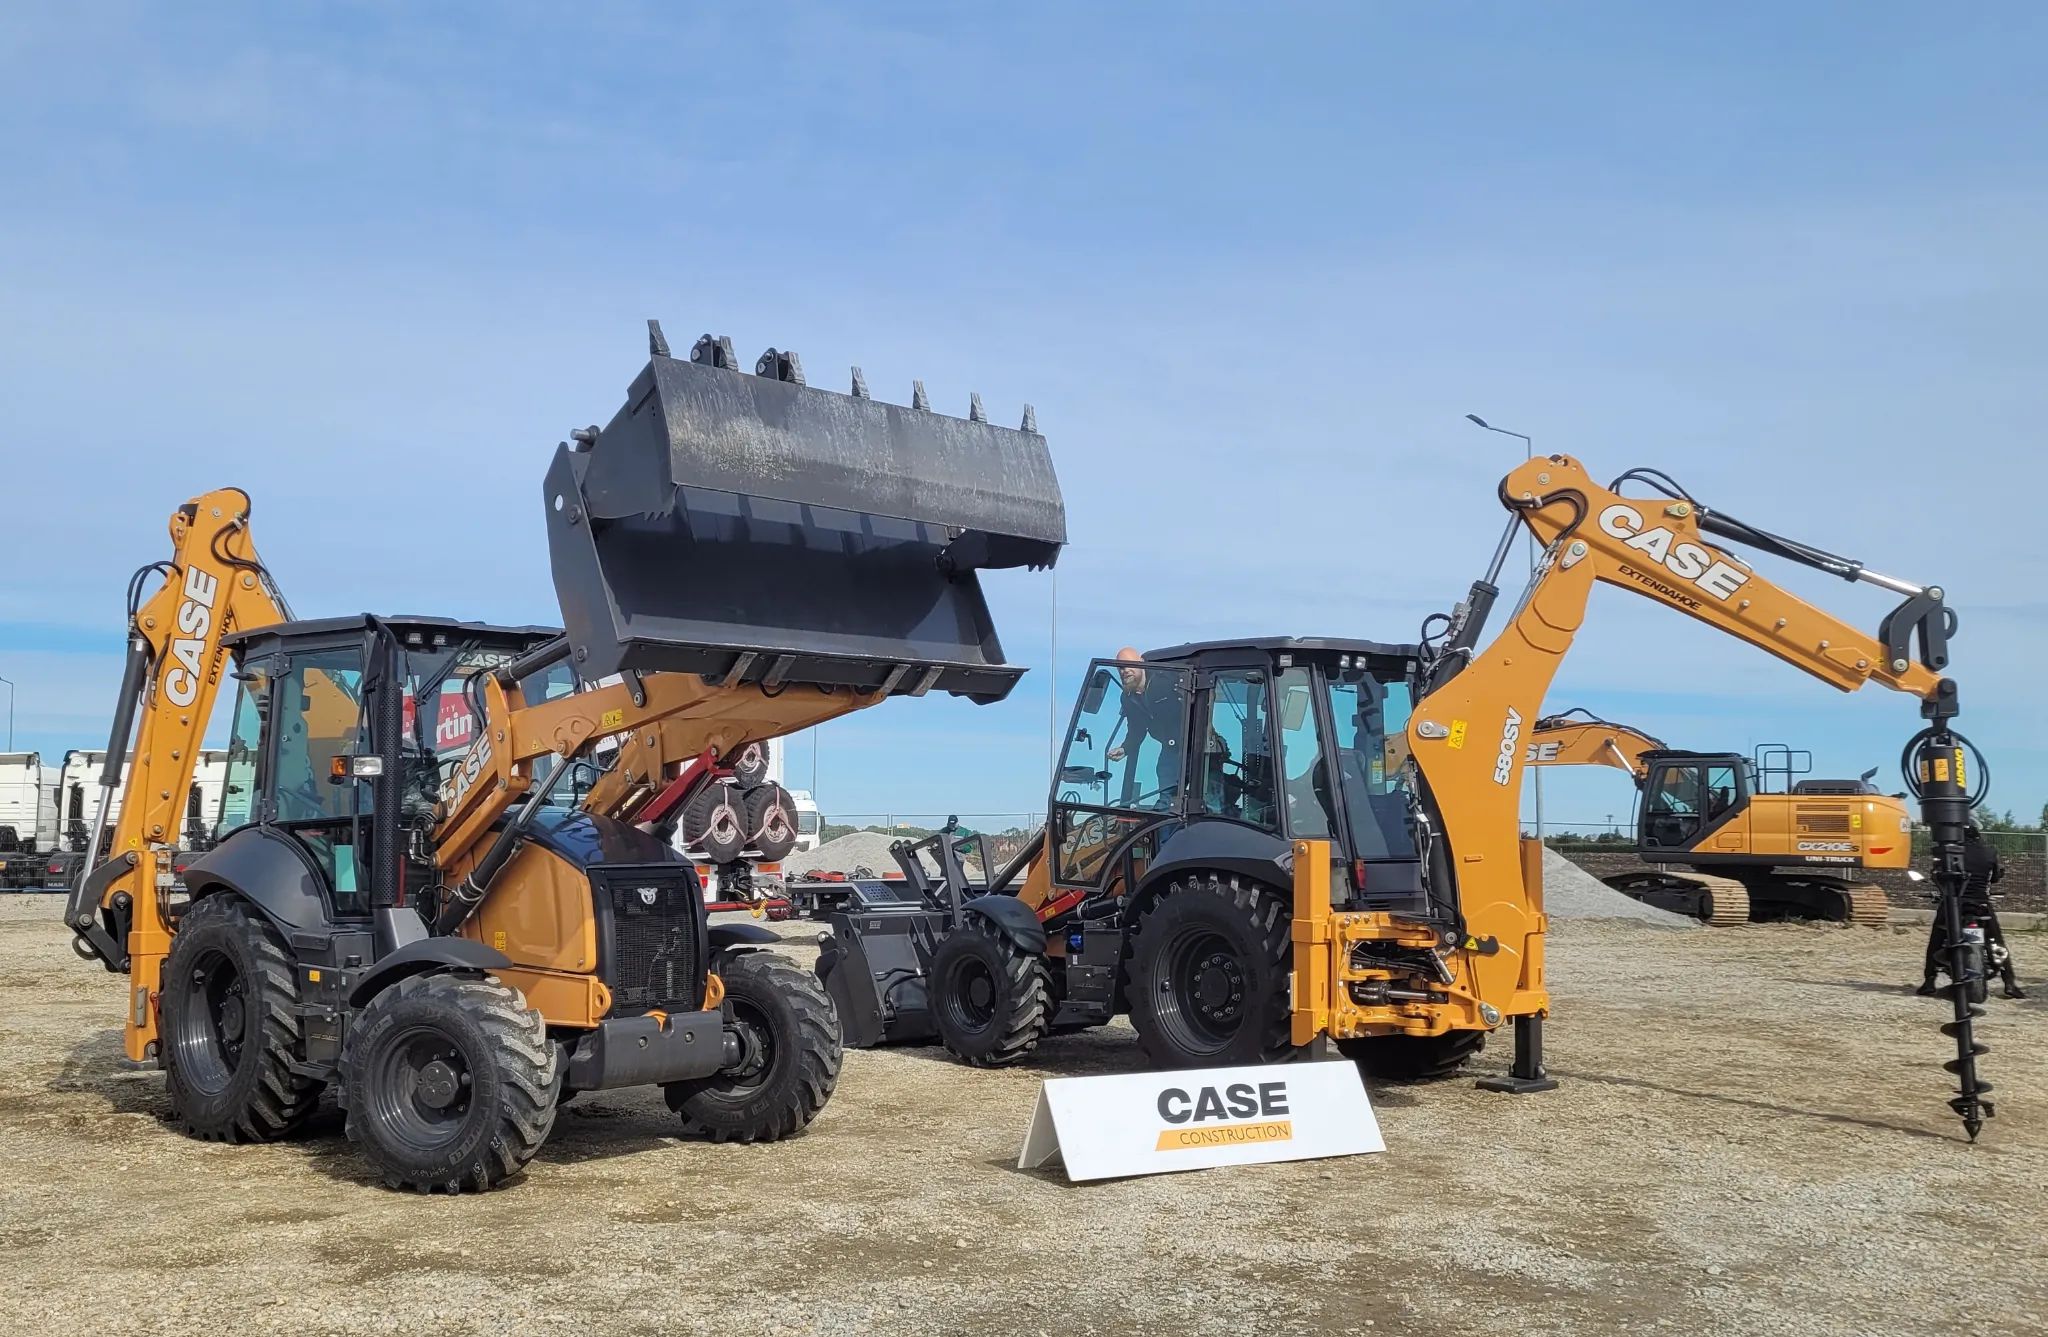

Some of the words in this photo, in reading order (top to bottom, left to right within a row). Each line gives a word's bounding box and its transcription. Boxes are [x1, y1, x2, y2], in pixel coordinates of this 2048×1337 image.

[1598, 504, 1750, 601] CASE
[1618, 565, 1702, 611] EXTENDAHOE
[164, 564, 218, 707] CASE
[436, 712, 473, 744] rtin
[1493, 705, 1522, 786] 580SV
[1524, 742, 1560, 761] SE
[447, 733, 492, 817] CASE
[1157, 1081, 1290, 1124] CASE
[1180, 1124, 1289, 1145] CONSTRUCTION
